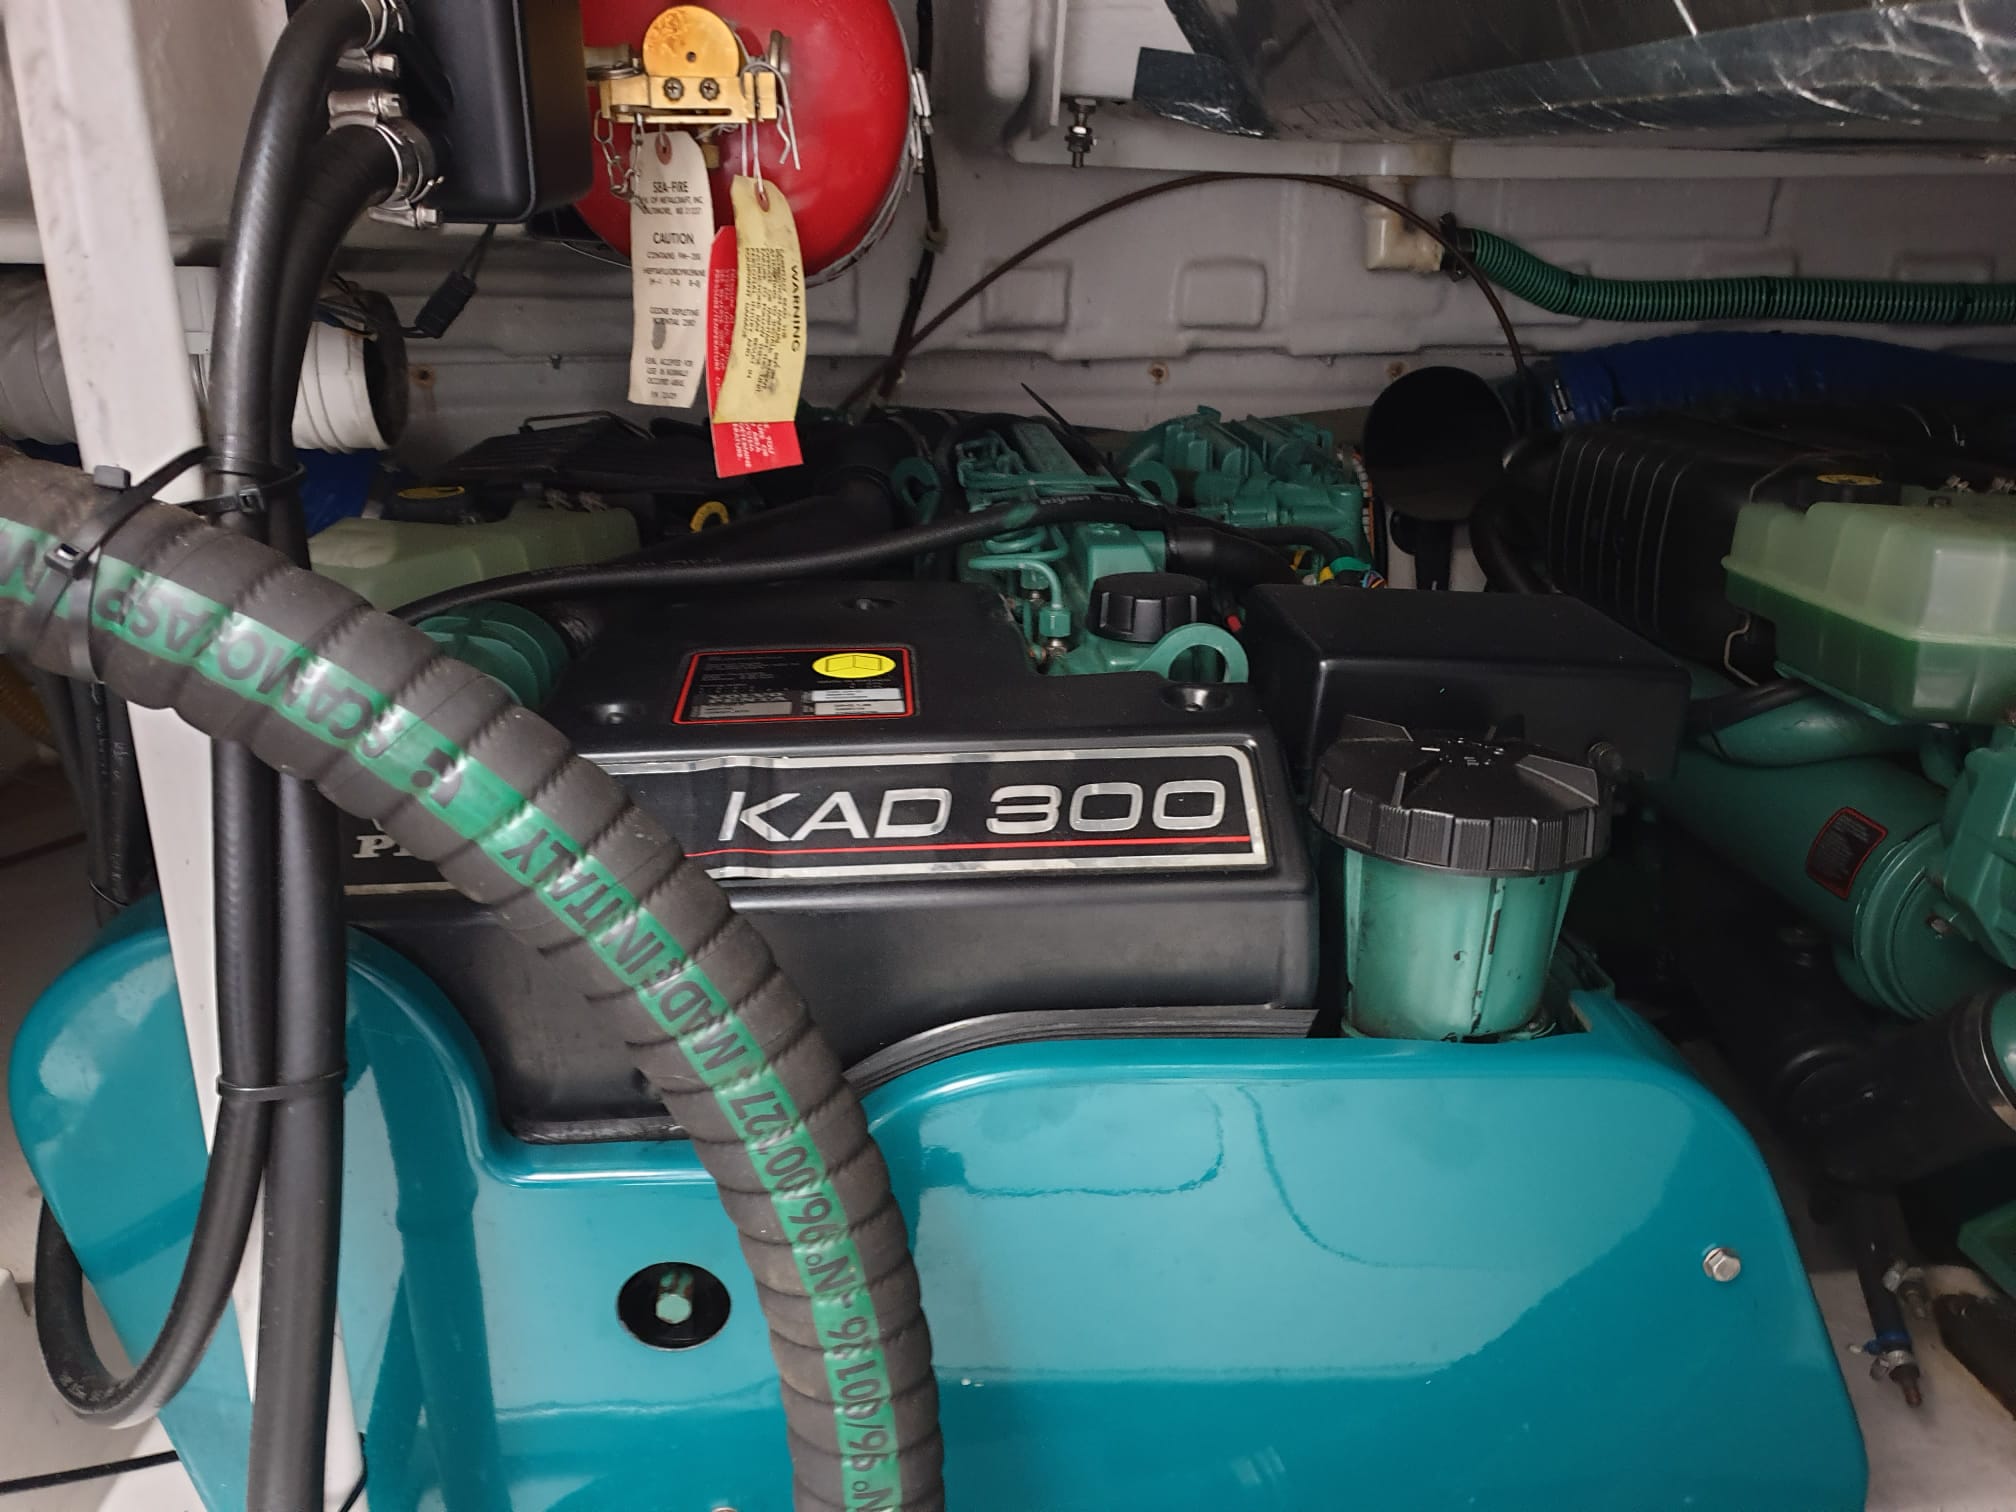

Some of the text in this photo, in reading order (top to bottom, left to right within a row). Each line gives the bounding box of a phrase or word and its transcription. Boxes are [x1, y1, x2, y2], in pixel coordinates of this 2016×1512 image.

[653, 232, 695, 245] CAUTION
[791, 265, 801, 352] WARNING
[718, 780, 1225, 842] KAD 300
[501, 828, 624, 931] ITALY
[601, 918, 664, 975] IN
[644, 957, 743, 1072] MADE
[805, 1252, 858, 1294] N°
